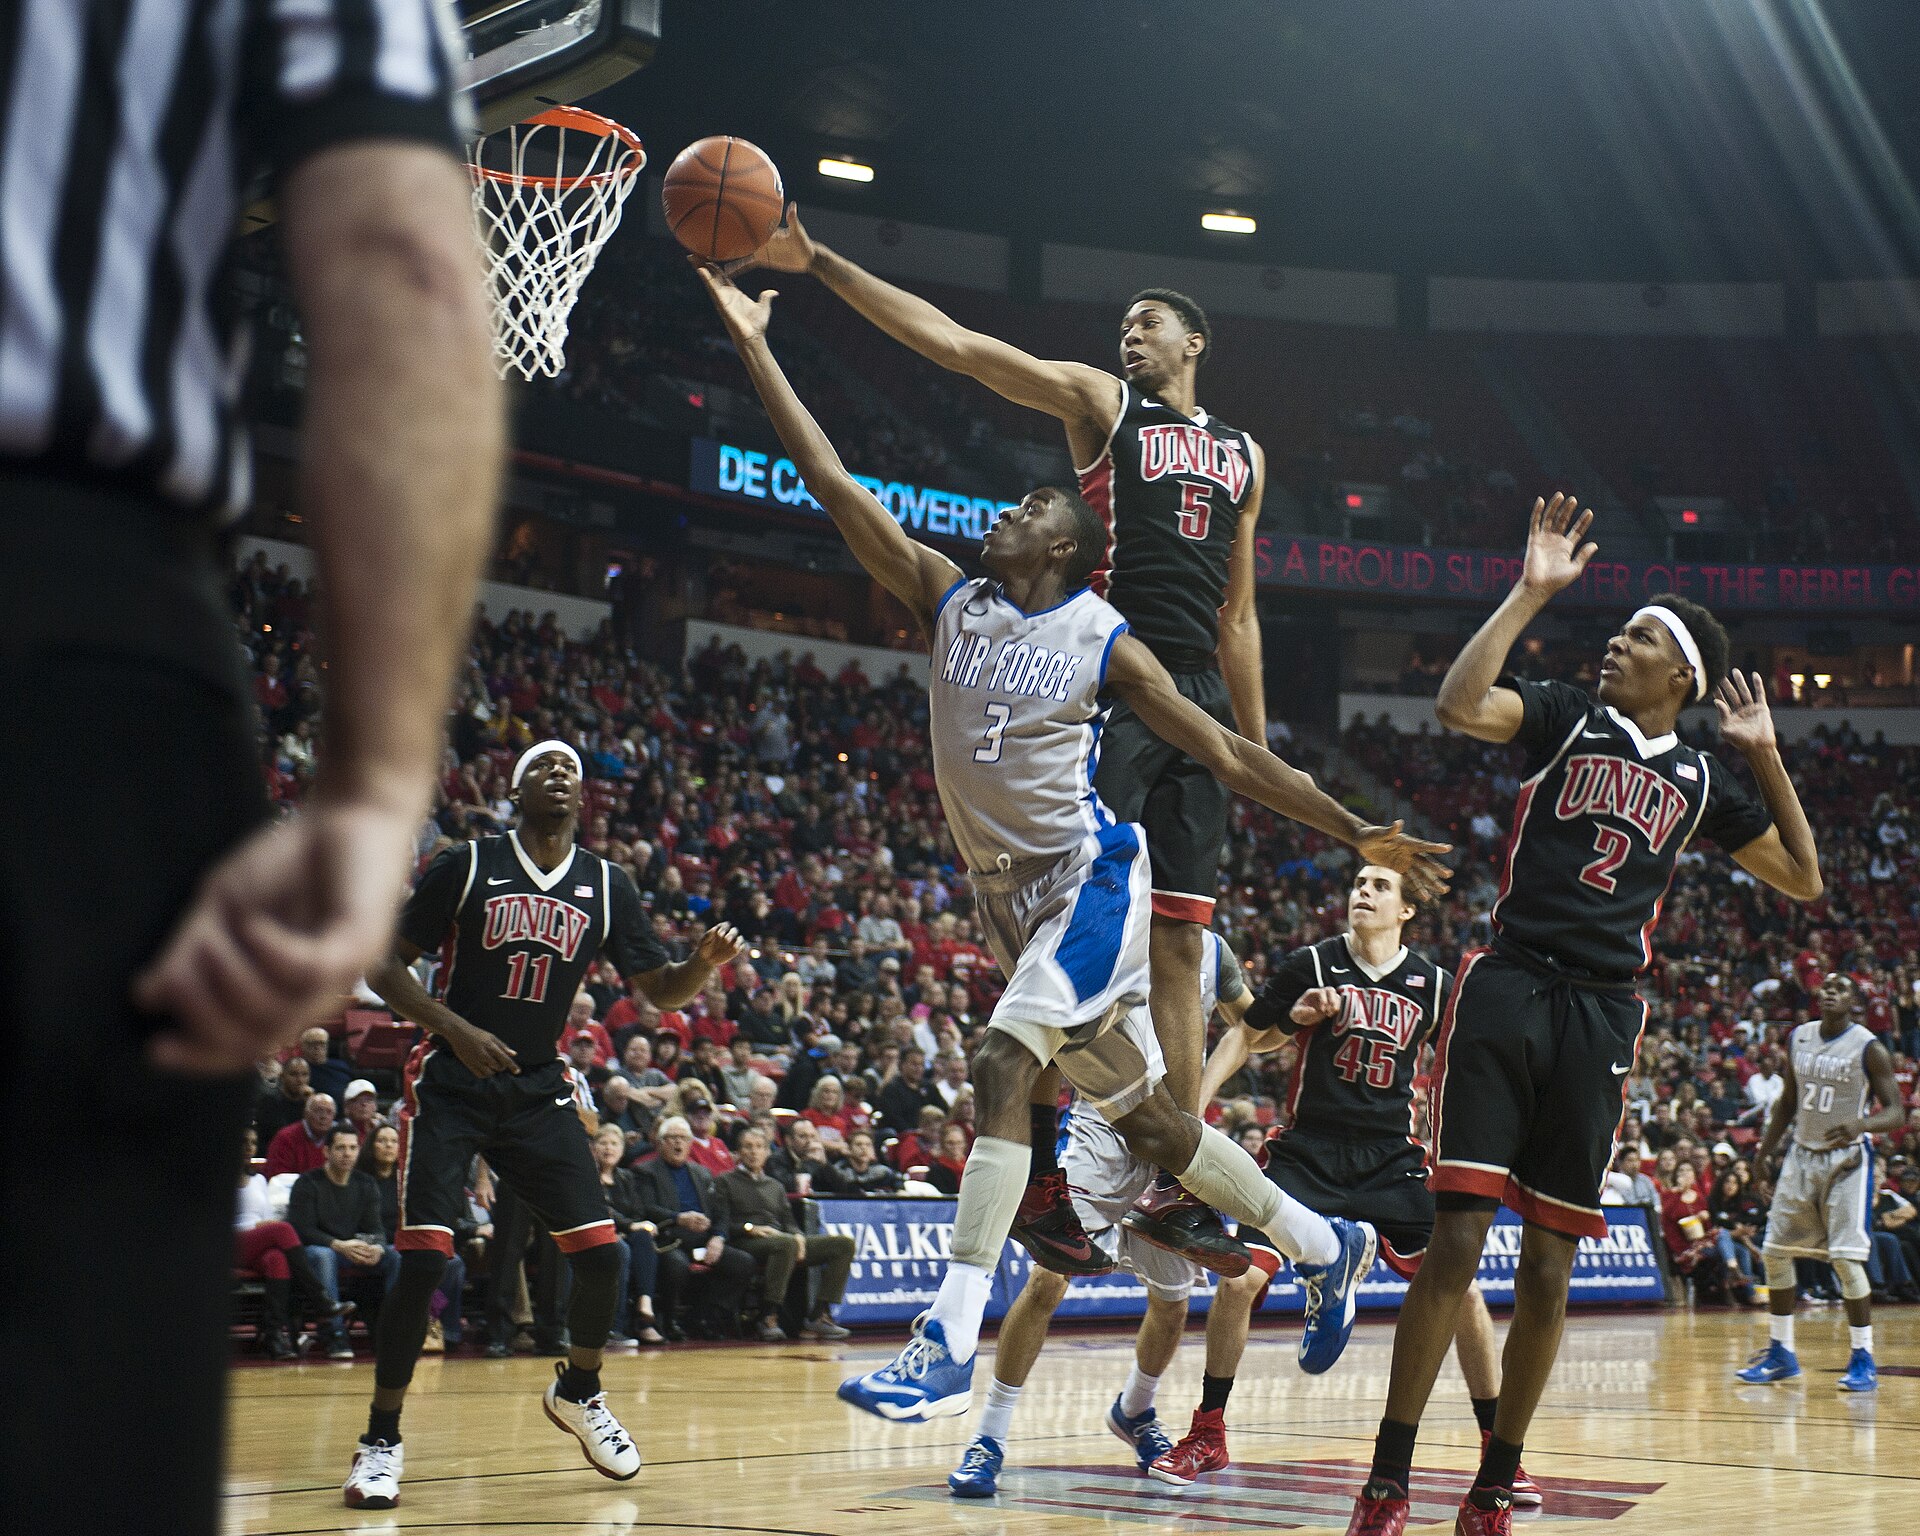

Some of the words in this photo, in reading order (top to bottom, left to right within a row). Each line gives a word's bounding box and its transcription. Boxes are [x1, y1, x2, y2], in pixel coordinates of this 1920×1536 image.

[718, 444, 767, 499] DE
[1138, 423, 1250, 505] UNLV
[1174, 480, 1214, 541] 5
[1282, 540, 1308, 582] A
[1318, 543, 1436, 590] PROUD
[1447, 555, 1631, 601] SUPPTER
[1700, 566, 1765, 603] THE
[1778, 567, 1873, 604] REBEL
[1887, 567, 1920, 604] G
[941, 630, 993, 688] AIR
[987, 640, 1084, 703] FORCE
[972, 701, 1012, 763] 3
[1555, 753, 1689, 856] UNLV
[1578, 820, 1632, 896] 2
[481, 893, 592, 962] UNLV
[498, 950, 553, 1003] 11
[1332, 983, 1424, 1052] UNLV
[1332, 1034, 1397, 1089] 45
[1801, 1082, 1836, 1114] 20
[825, 1222, 955, 1260] WALKE
